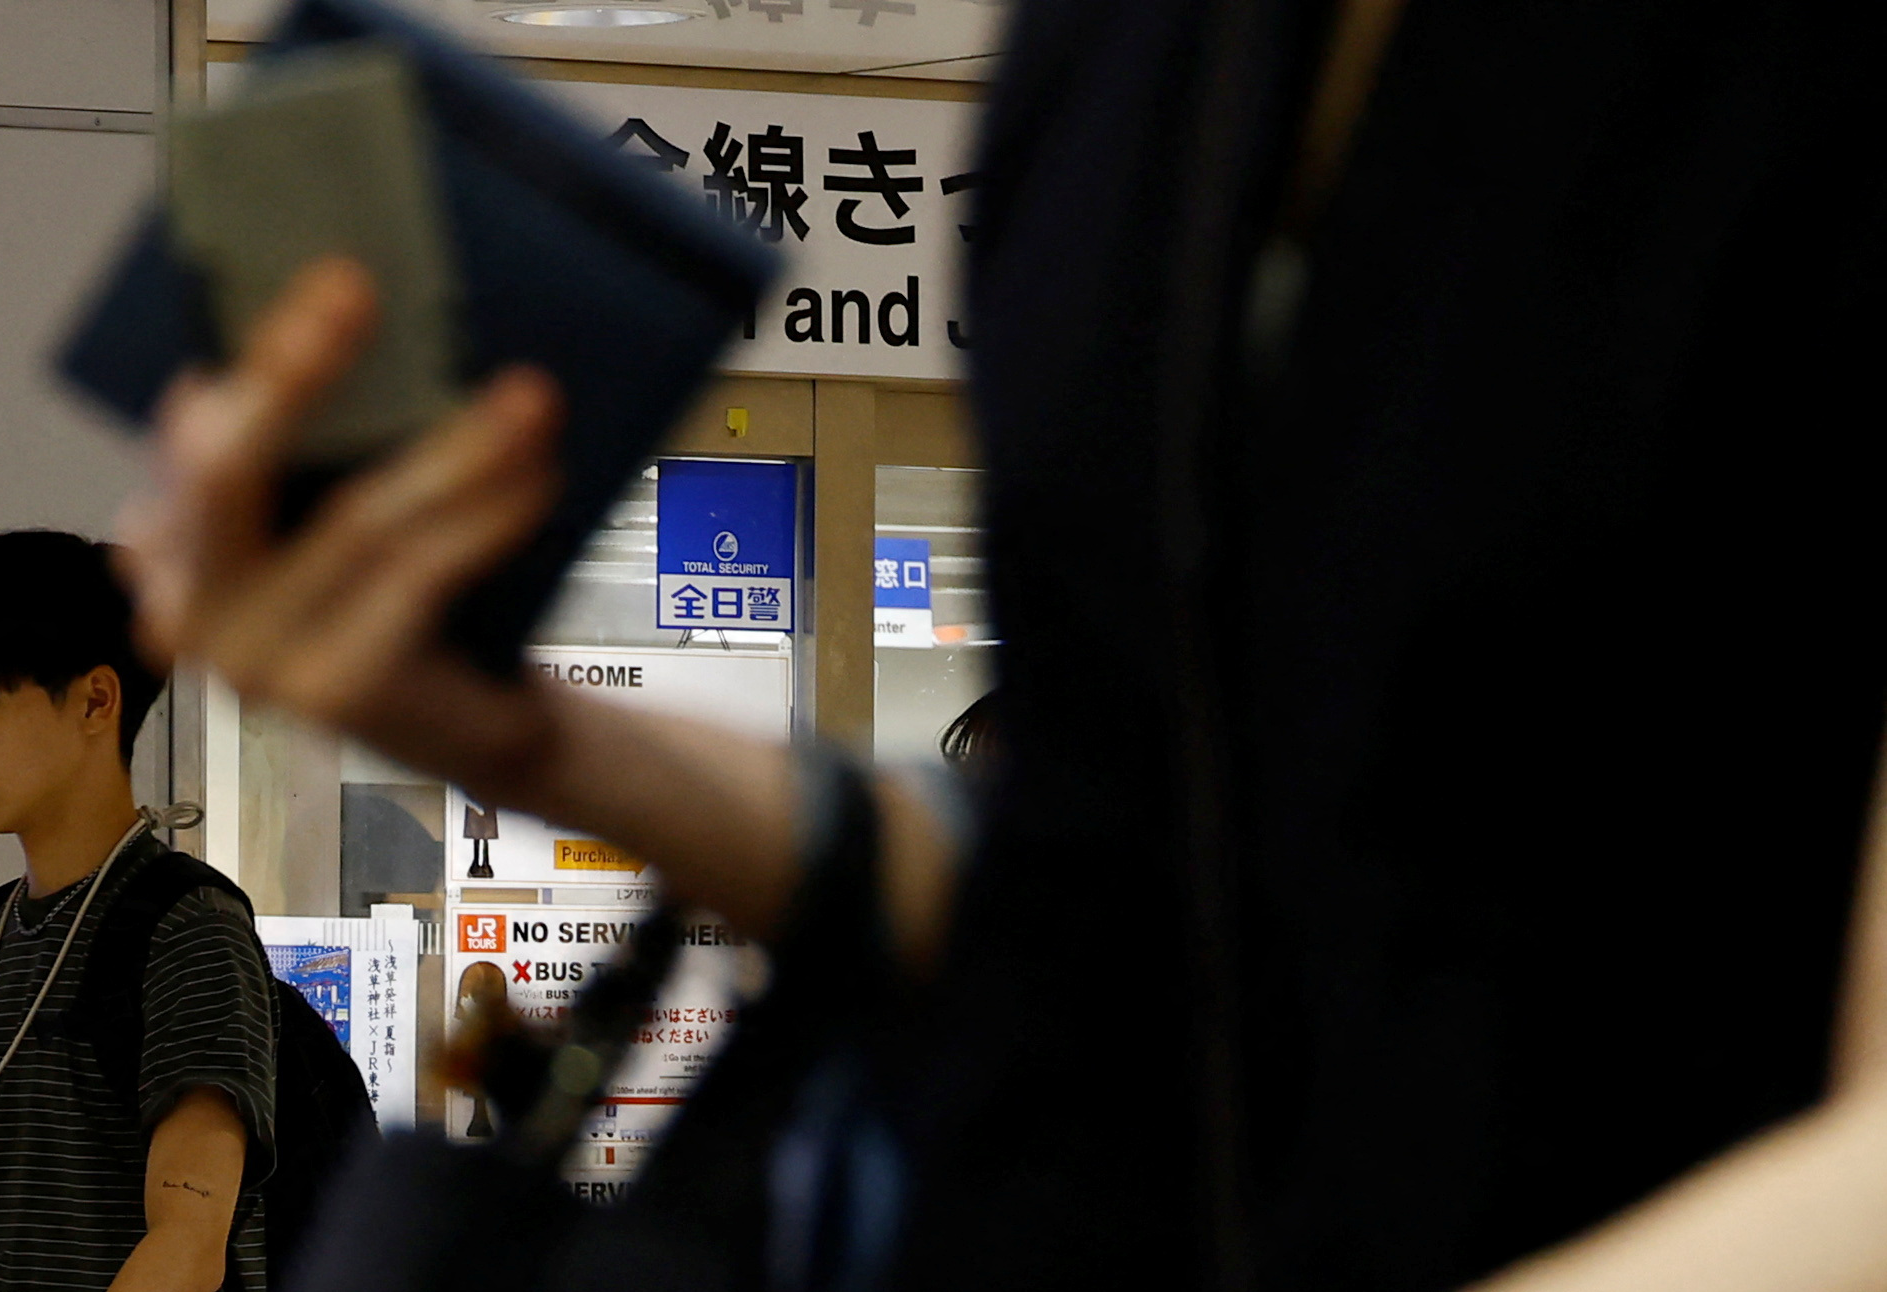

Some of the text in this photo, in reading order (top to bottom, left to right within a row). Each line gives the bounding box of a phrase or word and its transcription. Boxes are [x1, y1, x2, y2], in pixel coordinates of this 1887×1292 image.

[785, 275, 920, 347] and
[682, 561, 769, 575] TOTAL SECURITY
[670, 583, 781, 621] 全日警
[536, 663, 643, 688] ELCOME
[467, 917, 497, 938] JR
[513, 921, 549, 943] NO
[558, 922, 634, 945] SERV
[467, 938, 498, 949] TOURS
[535, 962, 583, 981] BUS
[545, 989, 570, 1000] BUS
